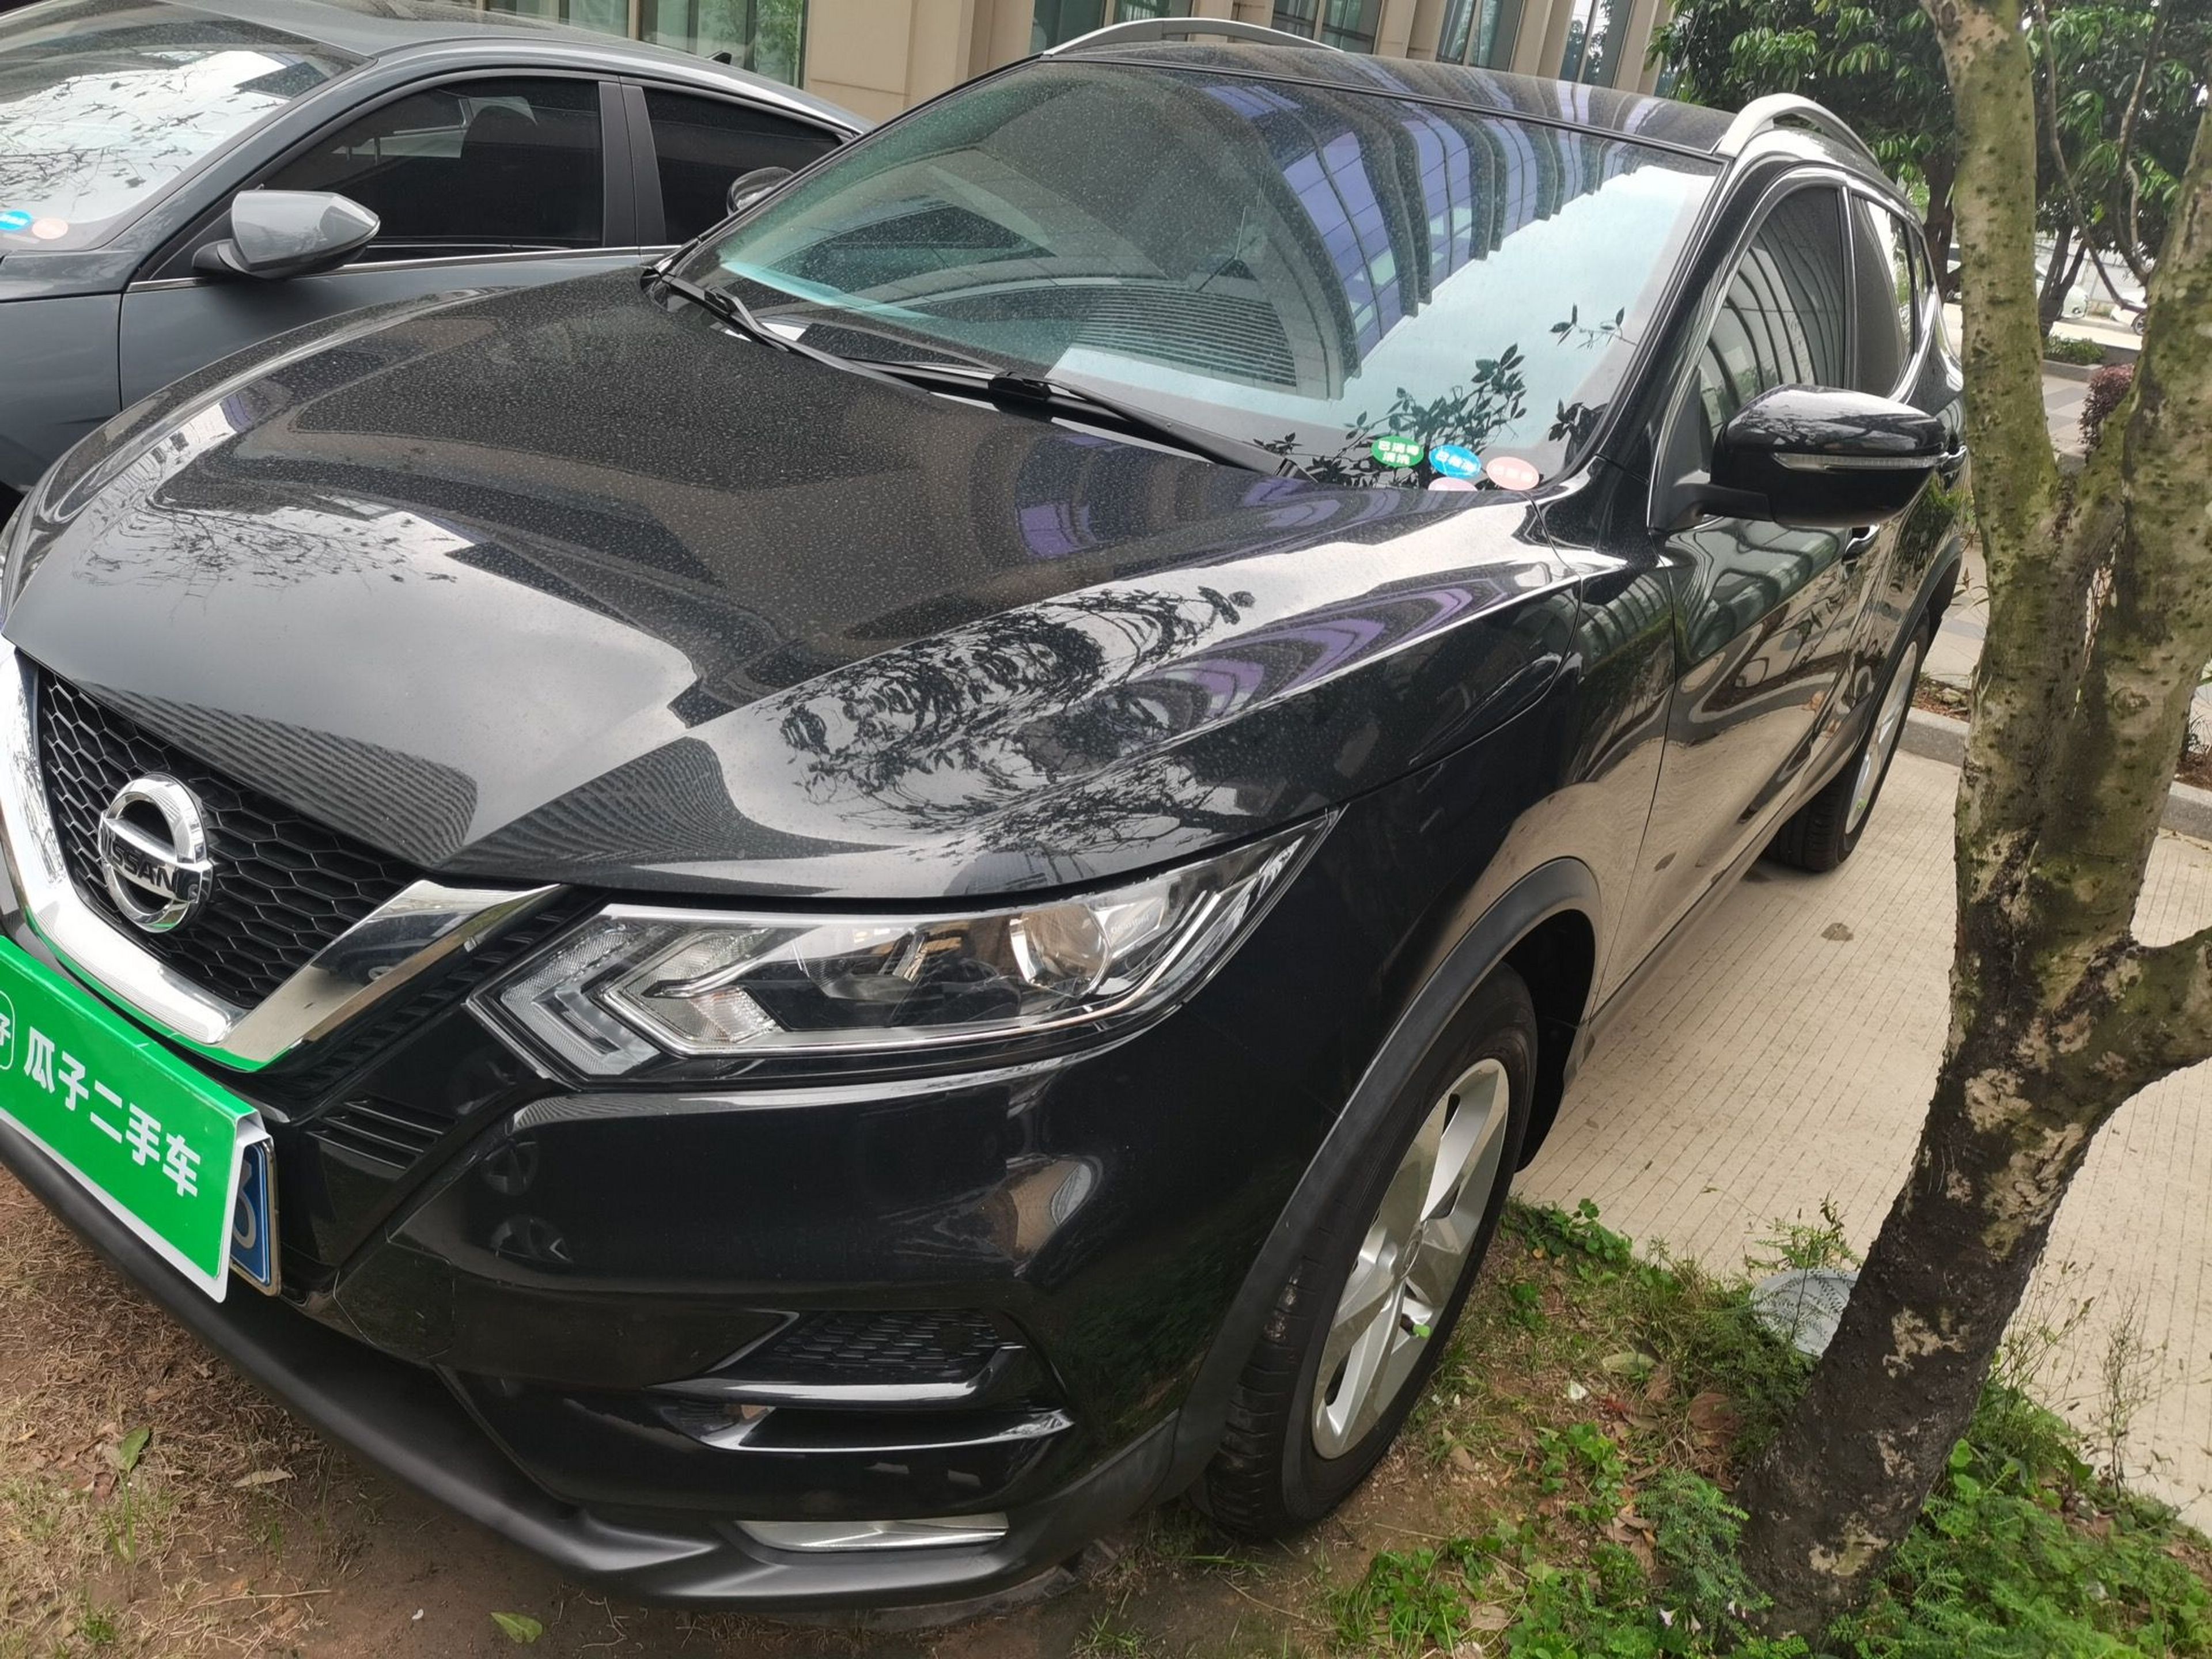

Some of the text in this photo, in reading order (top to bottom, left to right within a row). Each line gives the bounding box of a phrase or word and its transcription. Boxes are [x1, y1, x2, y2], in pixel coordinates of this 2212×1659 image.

[24, 1026, 200, 1198] 瓜子二手车
